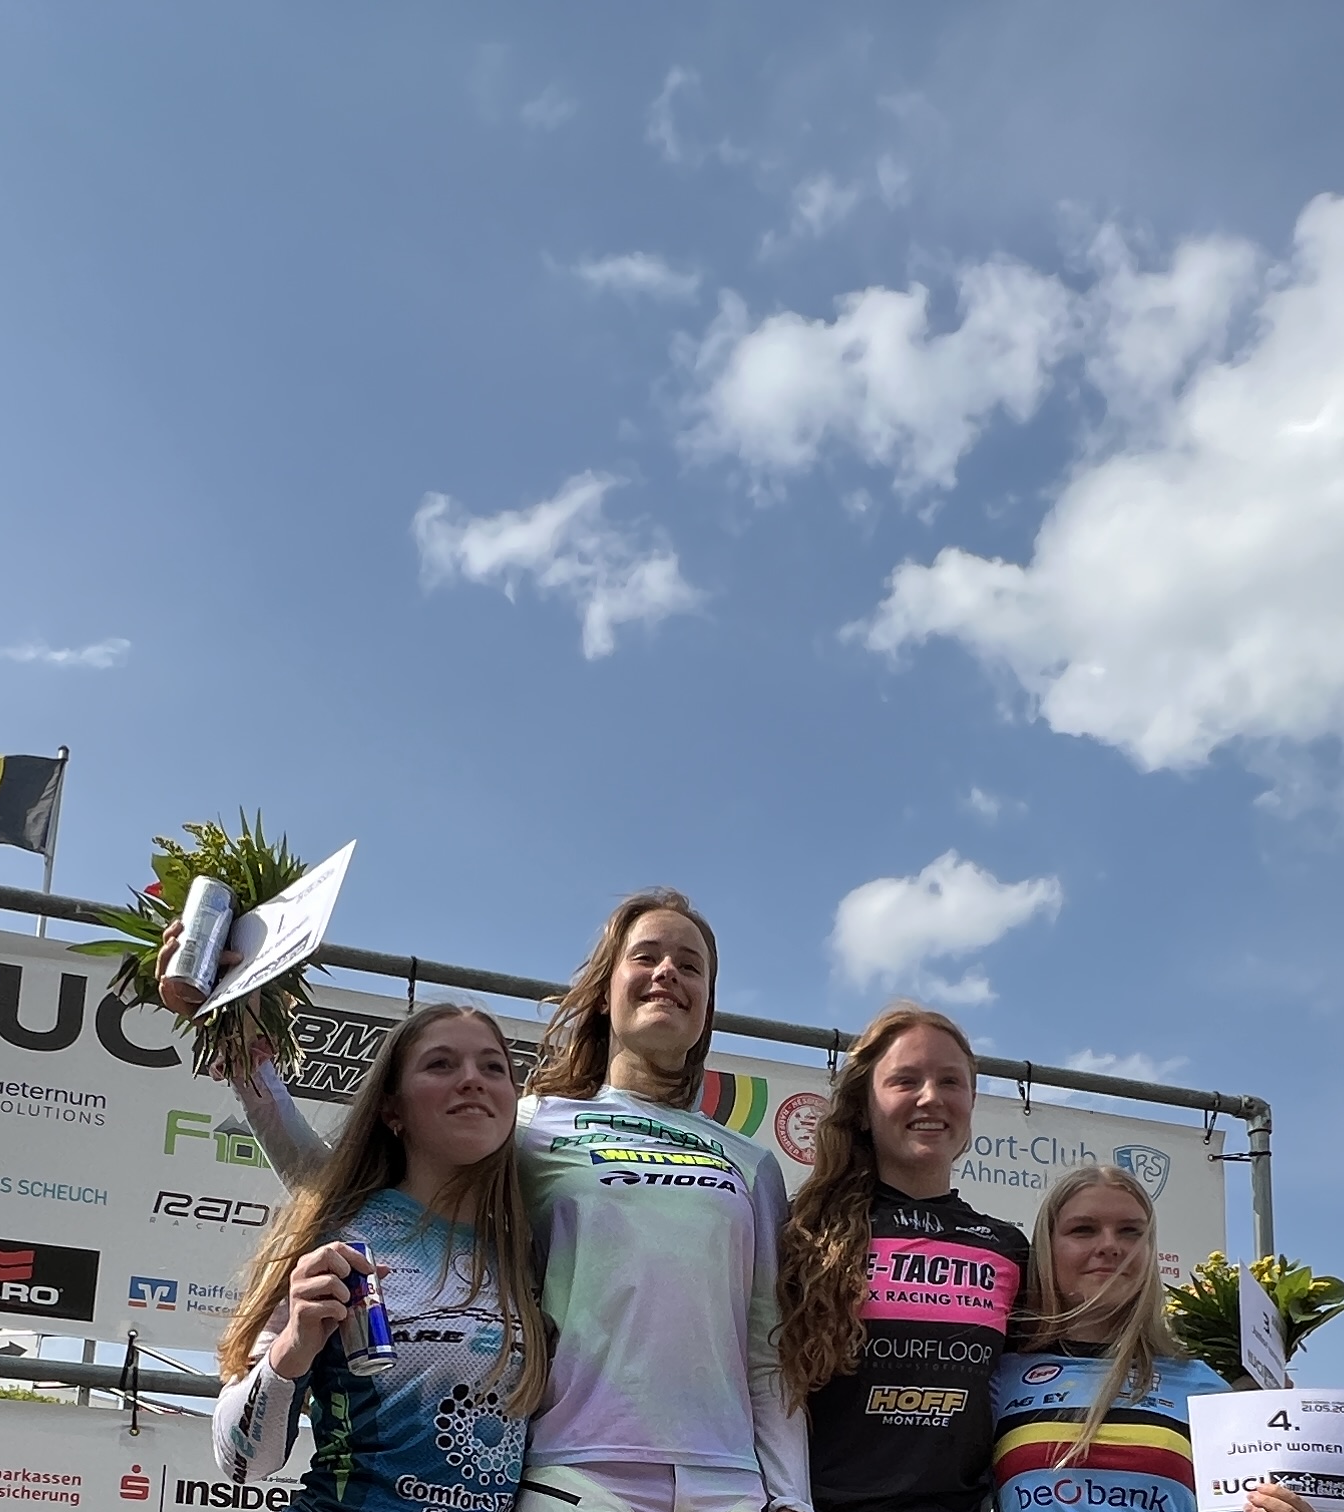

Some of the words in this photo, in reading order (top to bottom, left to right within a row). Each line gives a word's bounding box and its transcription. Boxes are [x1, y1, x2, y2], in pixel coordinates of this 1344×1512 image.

[288, 1014, 391, 1064] BM
[973, 1136, 1097, 1168] ort-Club
[17, 1179, 108, 1206] SCHEUCH
[643, 1173, 737, 1194] TIOGA
[149, 1216, 248, 1236] RACEL
[867, 1253, 996, 1291] E-TACTIC
[886, 1290, 951, 1305] RACING
[957, 1295, 994, 1310] TEAM
[862, 1338, 993, 1366] YOURFLOOR
[868, 1388, 966, 1415] HOFF
[1043, 1391, 1070, 1404] EY
[882, 1415, 950, 1427] MONTAGE
[1267, 1410, 1301, 1431] 4.
[1228, 1440, 1282, 1455] Junior
[1286, 1442, 1343, 1454] women
[395, 1474, 494, 1512] Comfort
